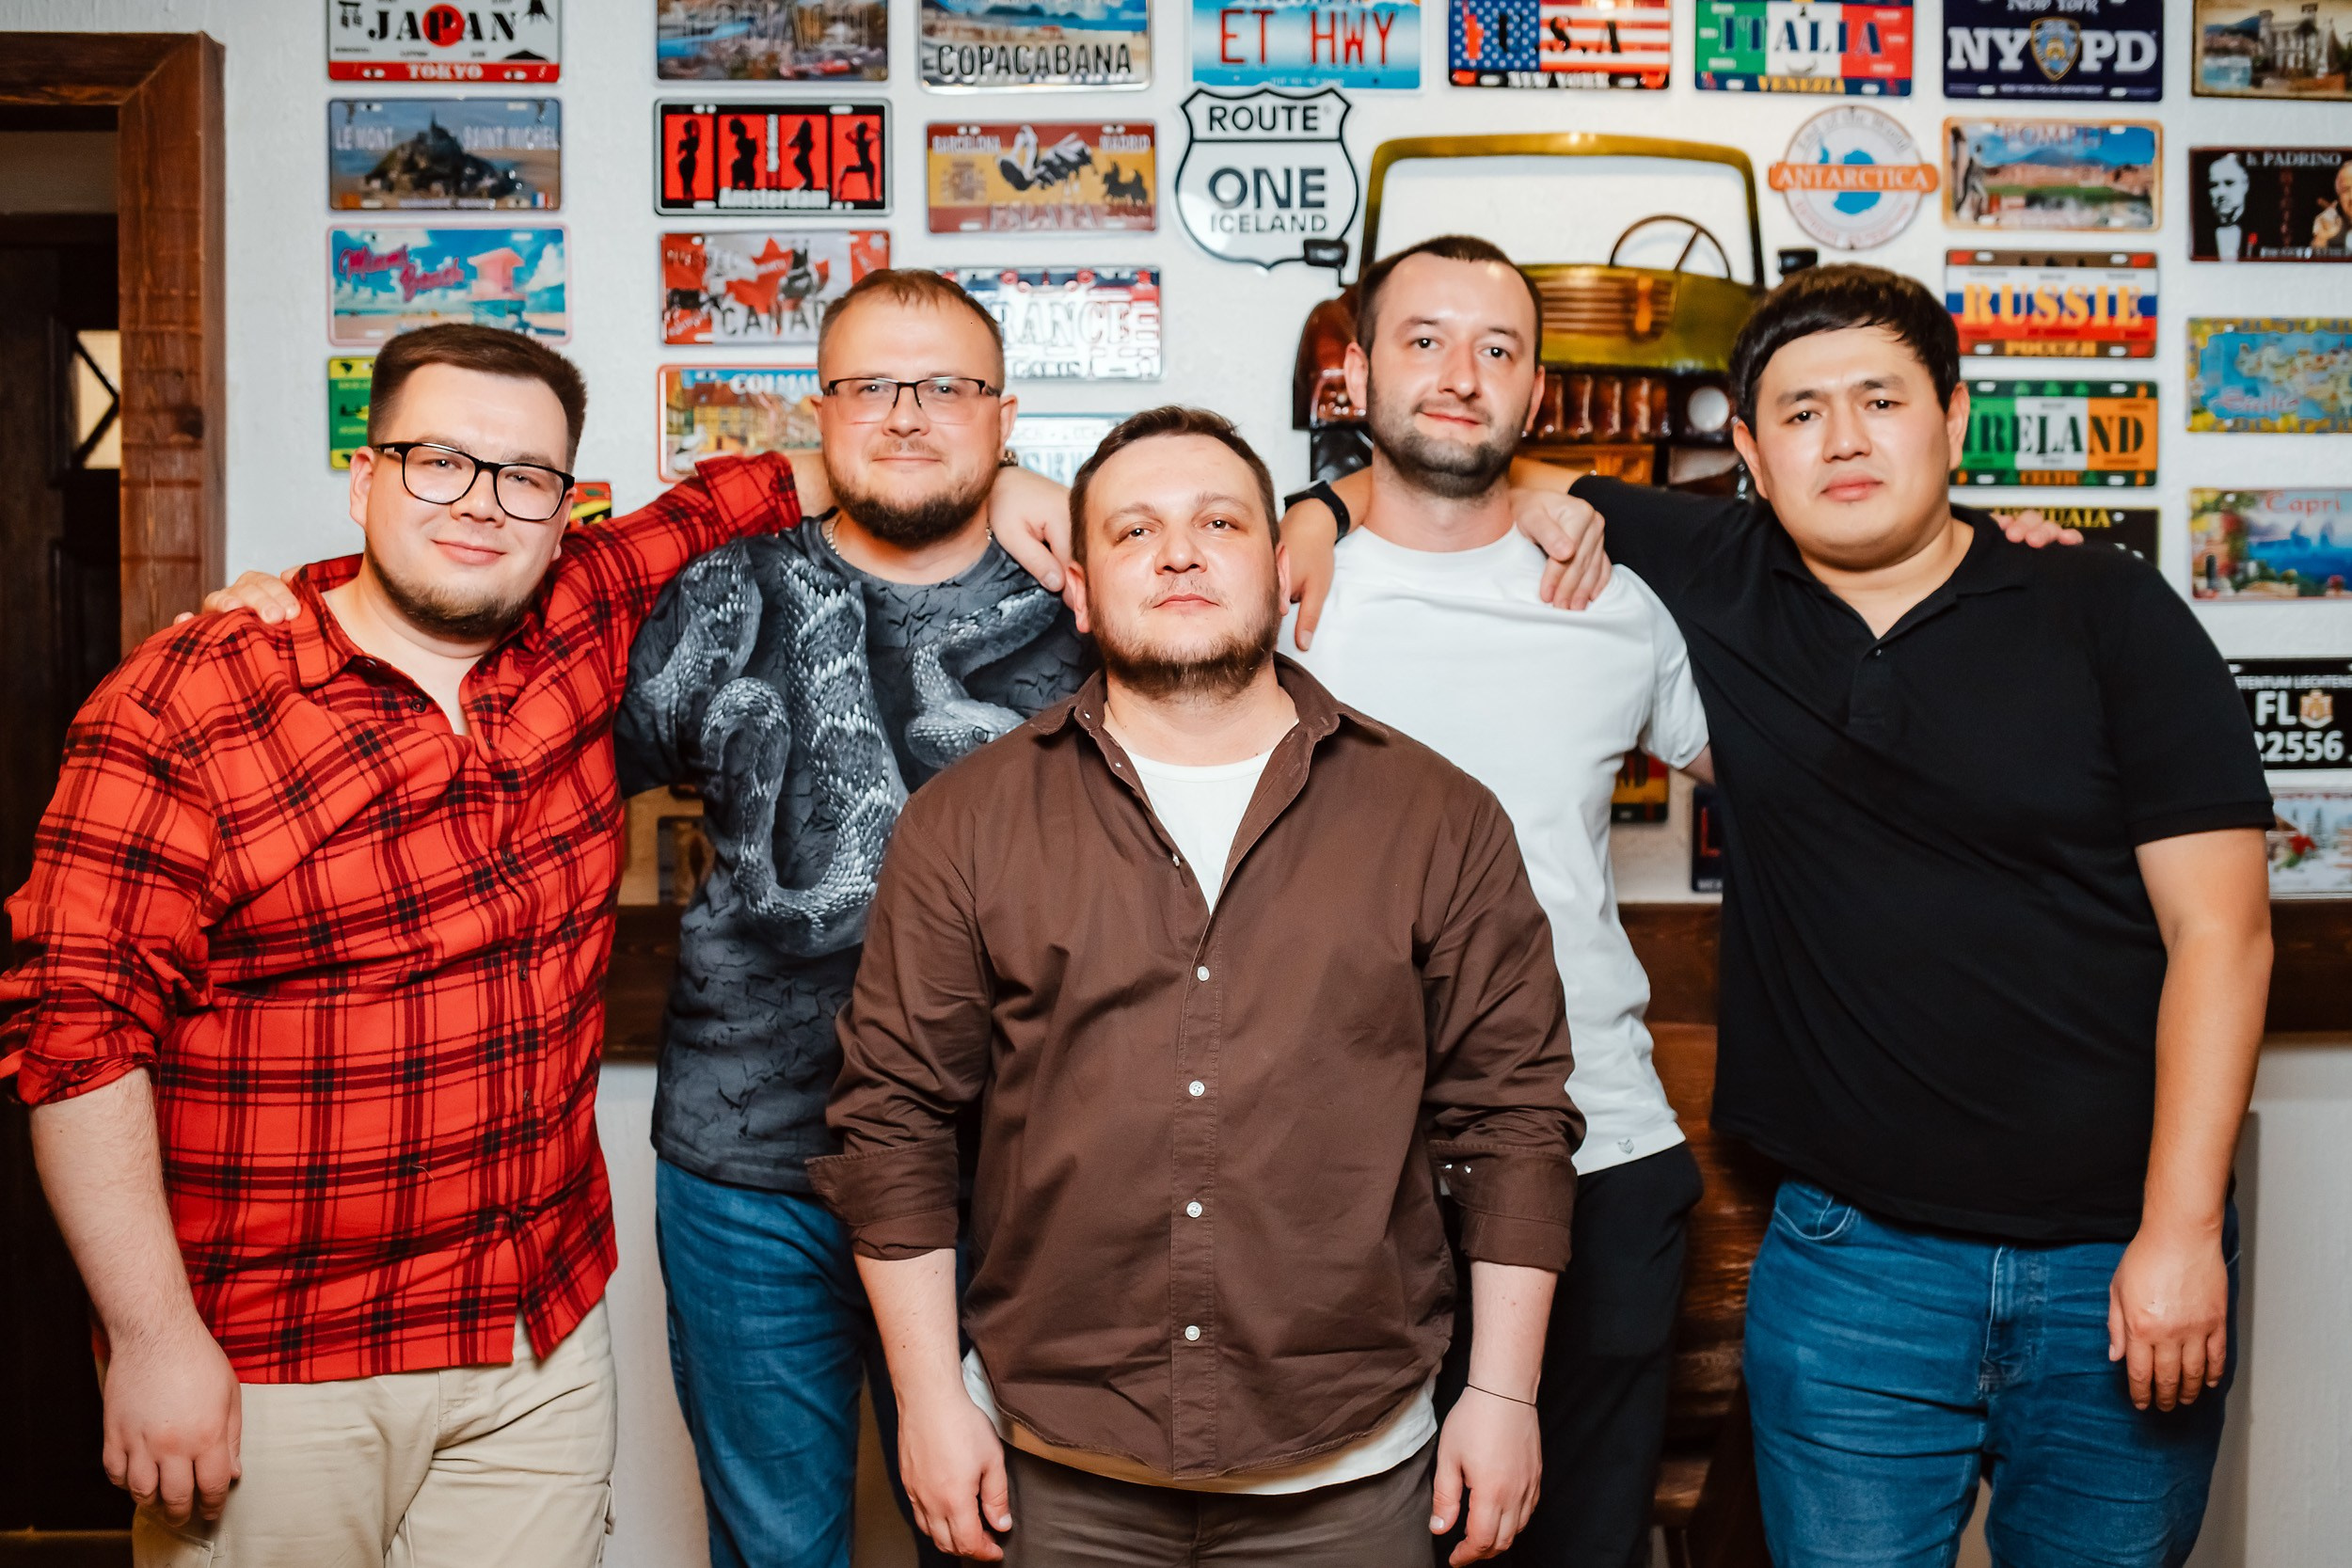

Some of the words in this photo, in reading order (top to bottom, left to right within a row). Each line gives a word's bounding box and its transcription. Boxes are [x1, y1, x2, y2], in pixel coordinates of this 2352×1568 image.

[368, 10, 516, 41] JAPAN
[1220, 9, 1275, 64] ET
[1311, 11, 1394, 65] HWY
[1719, 16, 1883, 55] ITALIA
[406, 64, 484, 80] TOKYO
[938, 43, 1132, 75] COPACABANA
[1209, 105, 1318, 132] ROUTE
[2263, 152, 2343, 166] PADRINO
[1208, 167, 1326, 209] ONE
[1777, 167, 1929, 189] ANTARCTICA
[1210, 214, 1327, 234] ICELAND
[1962, 283, 2143, 327] RUSSIE
[1962, 416, 2145, 454] IRELAND
[2265, 490, 2342, 516] Capri
[2255, 690, 2297, 725] FL
